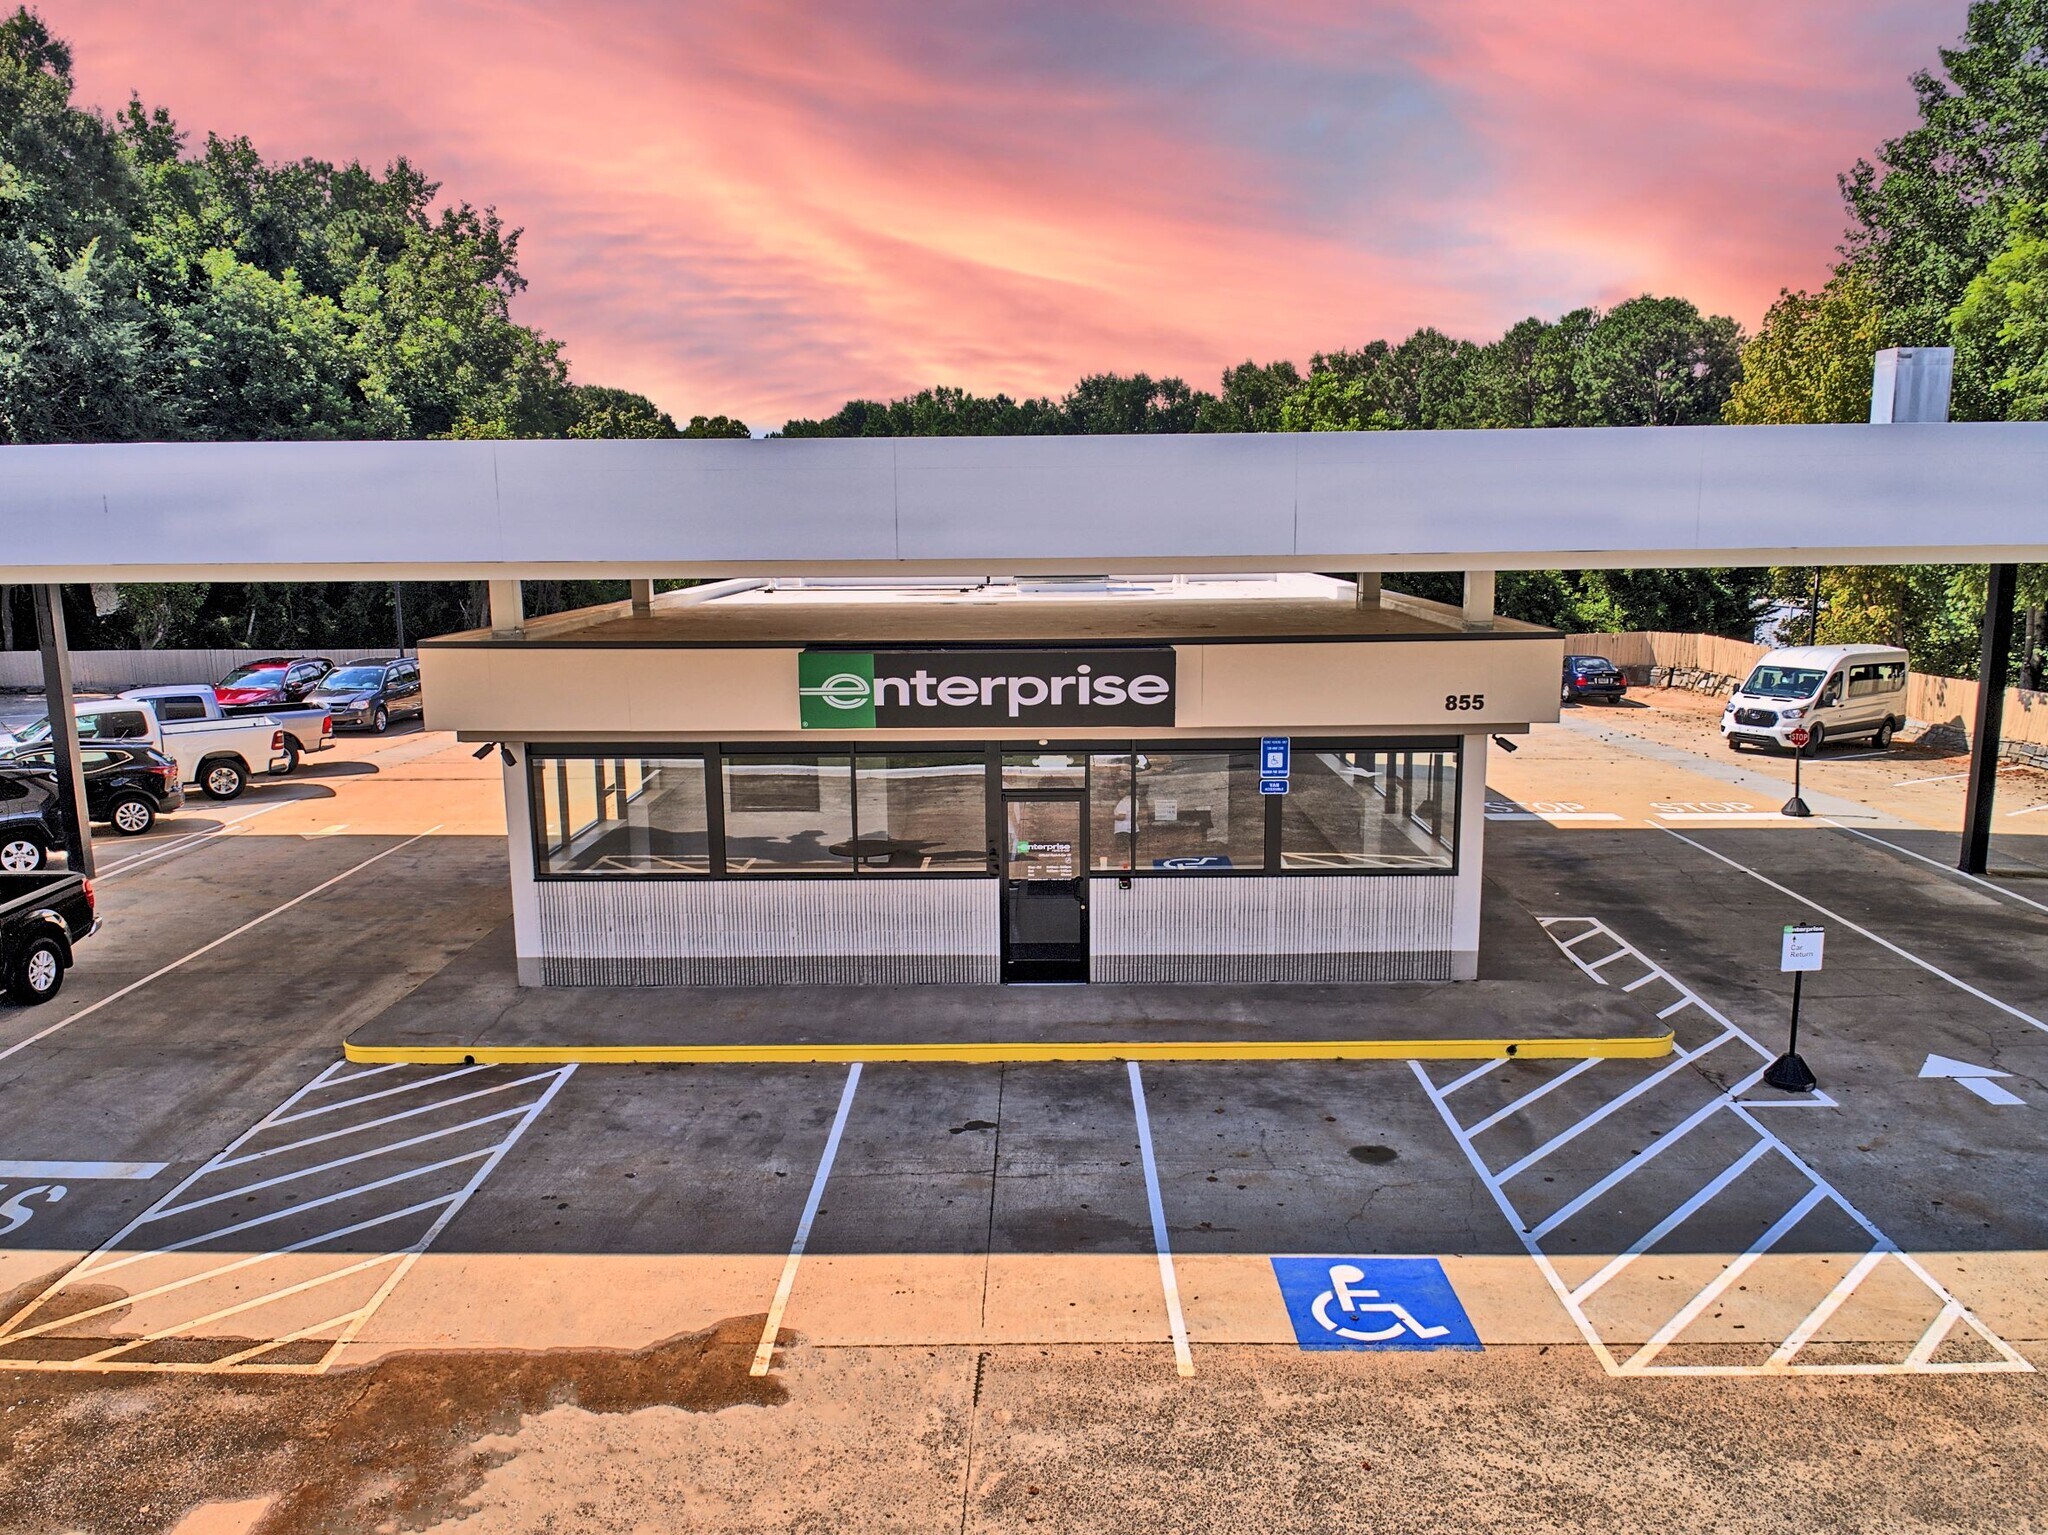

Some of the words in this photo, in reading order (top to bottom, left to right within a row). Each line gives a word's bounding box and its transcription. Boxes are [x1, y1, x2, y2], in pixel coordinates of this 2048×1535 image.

[800, 664, 1170, 717] enterprise
[1445, 694, 1484, 711] 855
[1791, 733, 1808, 741] STOP
[1484, 801, 1585, 813] STOP
[1649, 801, 1754, 814] STOP
[1017, 842, 1071, 852] enterprise
